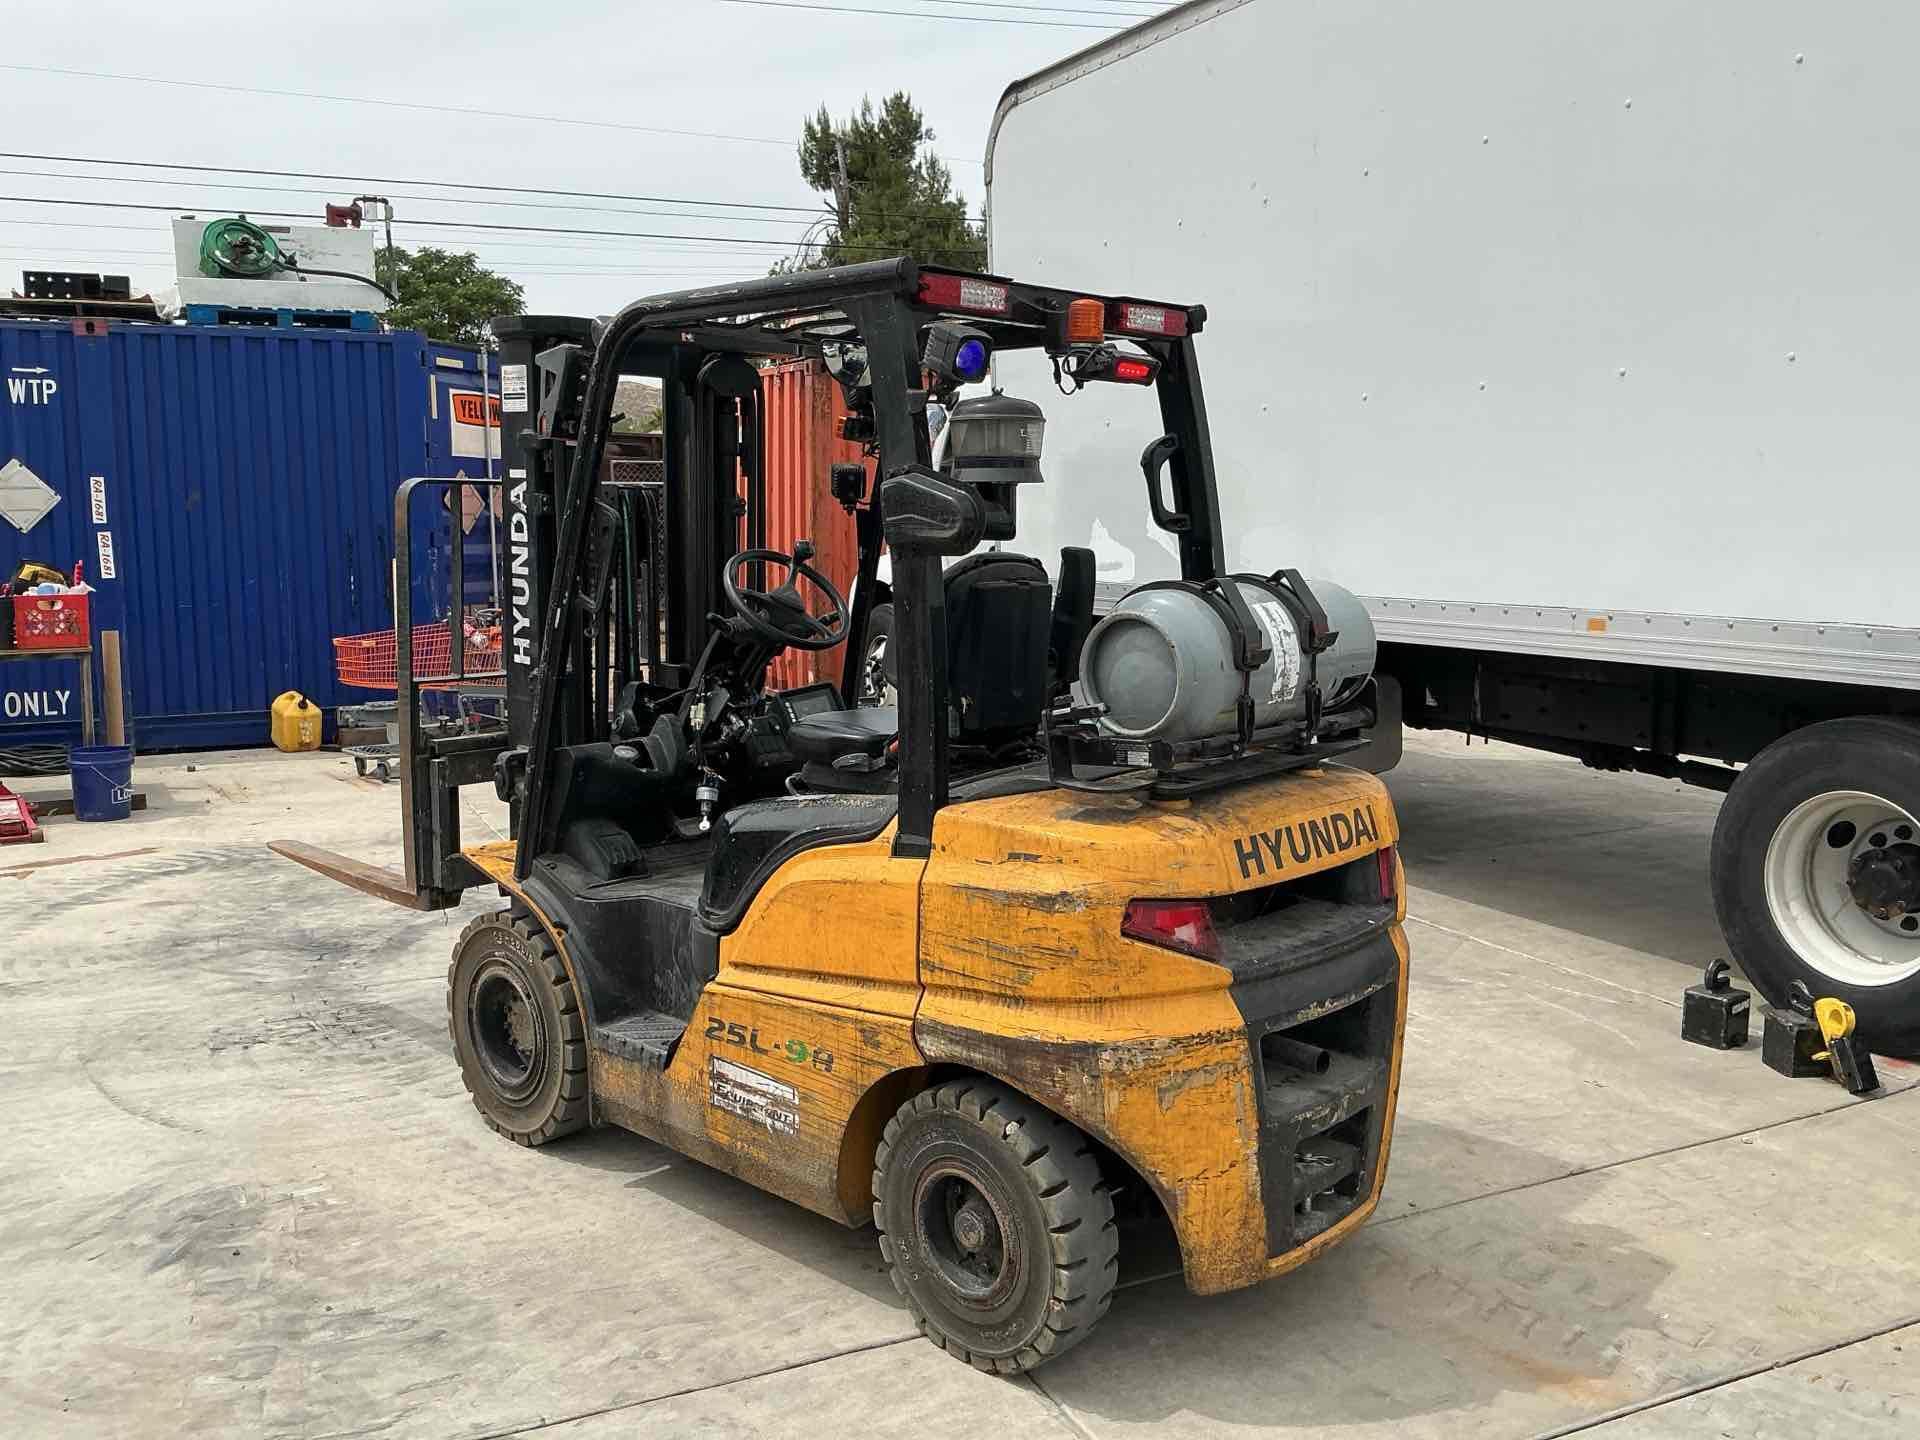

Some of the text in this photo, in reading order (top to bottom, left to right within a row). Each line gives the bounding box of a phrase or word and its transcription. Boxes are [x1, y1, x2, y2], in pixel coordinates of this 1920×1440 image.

[7, 378, 57, 405] WTP
[509, 468, 531, 665] HYUNDAI
[4, 689, 70, 718] ONLY
[1233, 803, 1380, 879] HYUNDAI
